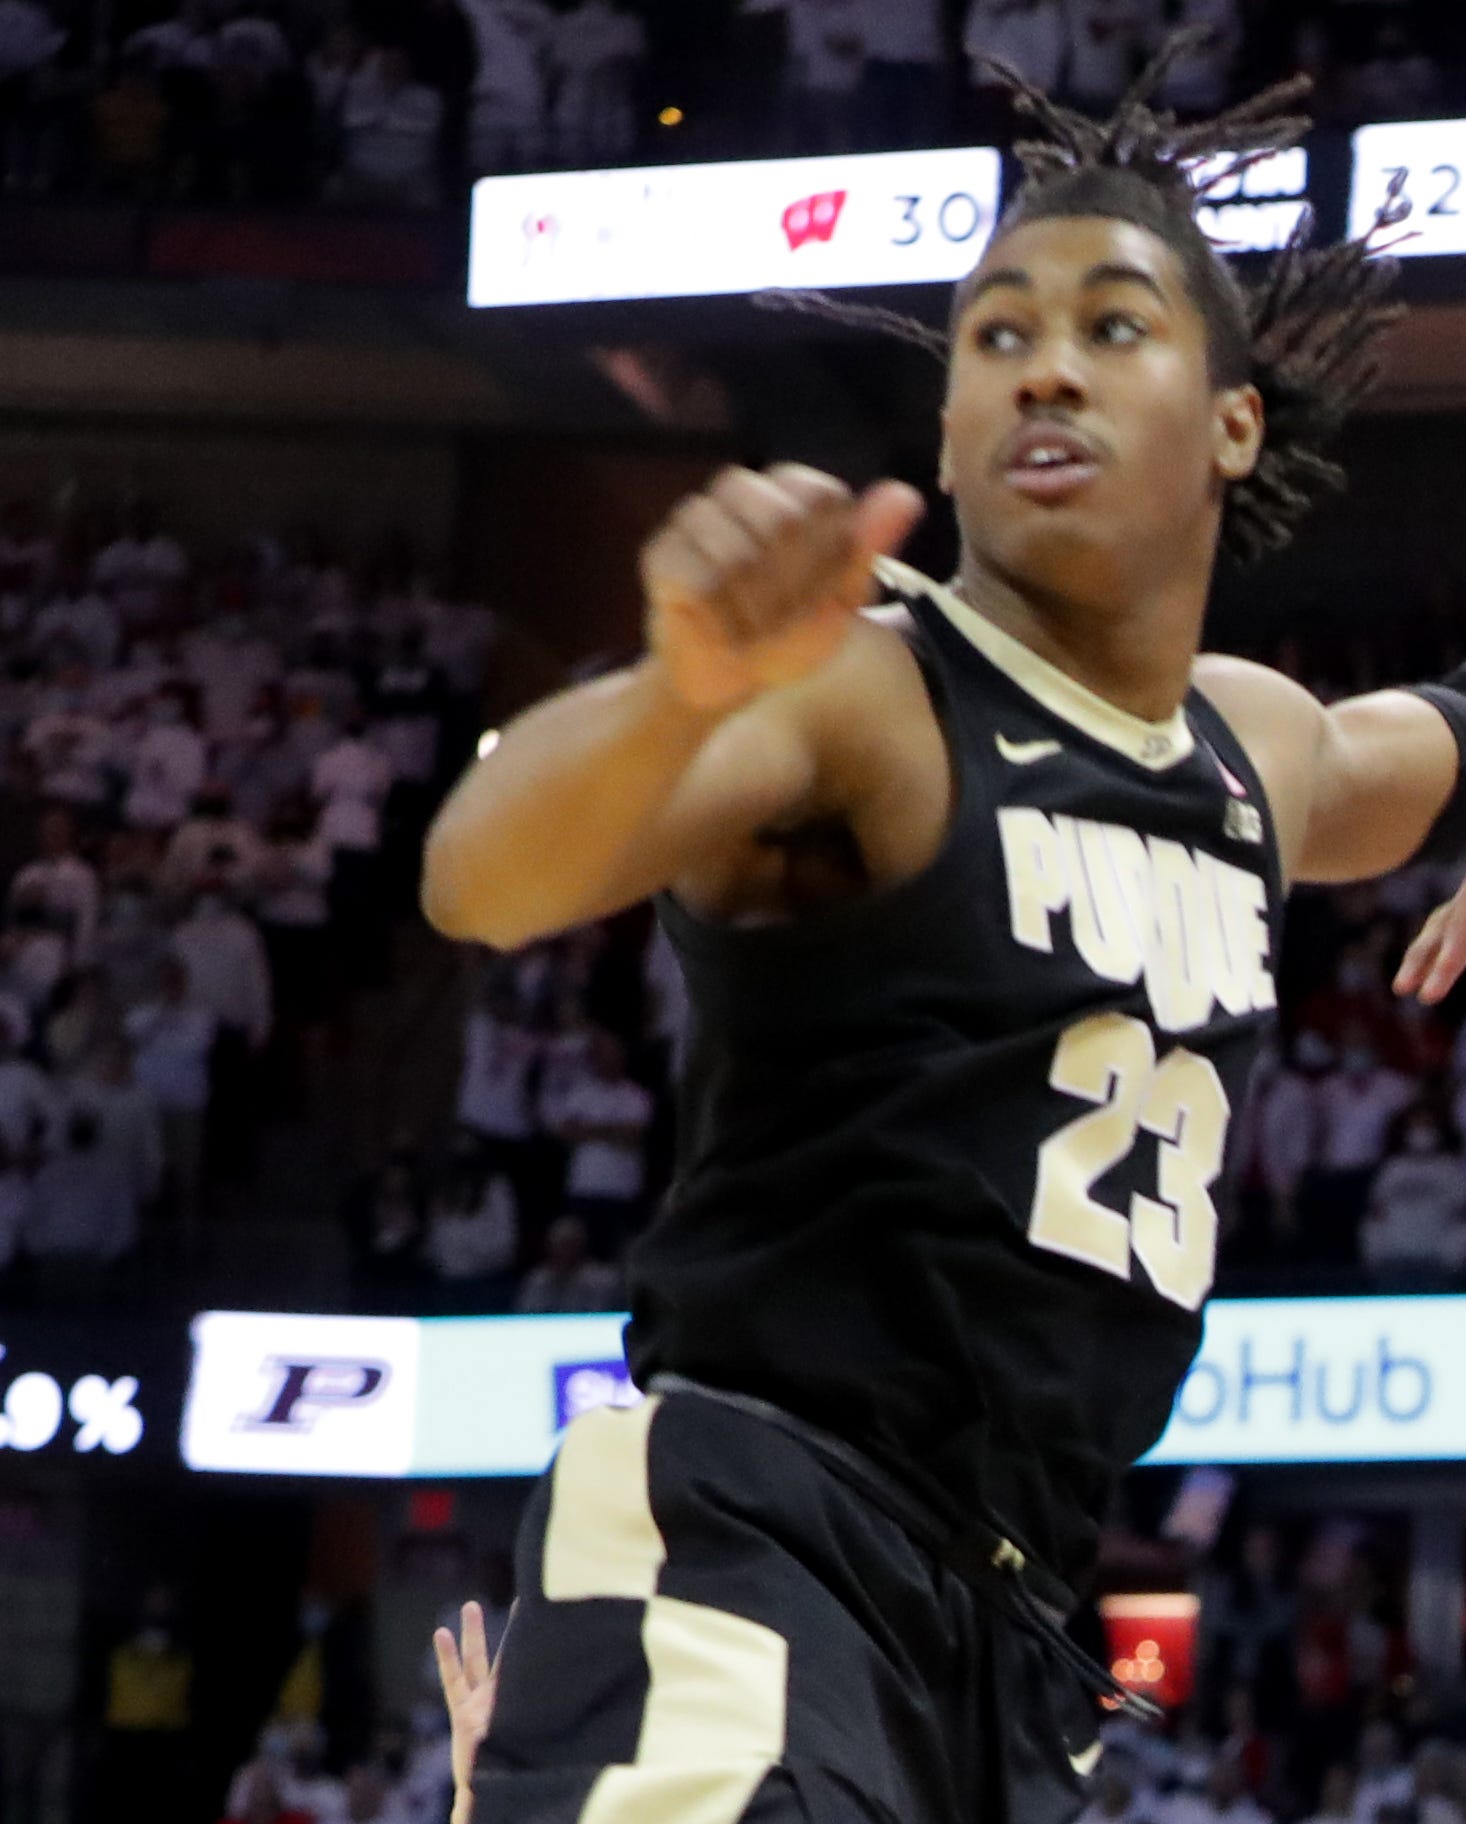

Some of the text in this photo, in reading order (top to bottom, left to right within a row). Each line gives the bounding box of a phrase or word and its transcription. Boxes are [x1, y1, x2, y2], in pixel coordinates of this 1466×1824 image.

[892, 192, 982, 247] 30
[996, 805, 1278, 1034] PURDUE
[1027, 1009, 1231, 1313] 23
[228, 1353, 393, 1435] P
